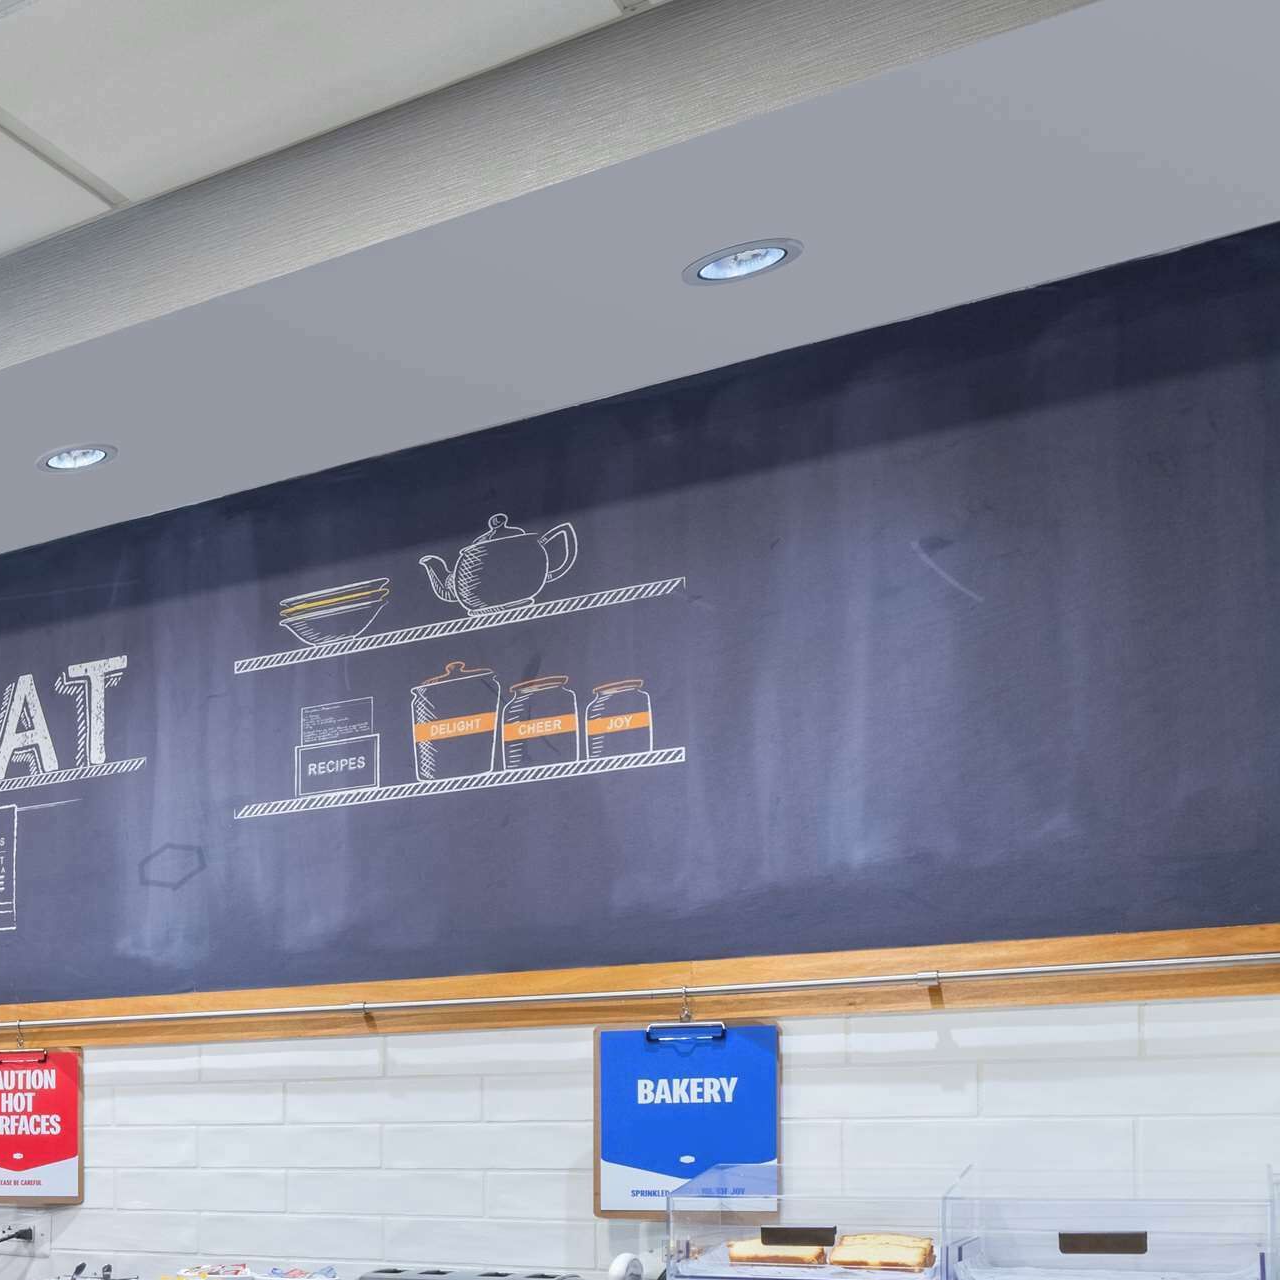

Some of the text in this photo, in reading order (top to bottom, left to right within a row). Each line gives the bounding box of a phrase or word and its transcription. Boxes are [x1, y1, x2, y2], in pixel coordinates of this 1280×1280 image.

[430, 718, 482, 736] DELIGHT
[518, 719, 562, 736] CHEER
[607, 715, 633, 730] JOY
[308, 756, 366, 776] RECIPES
[637, 1077, 738, 1104] BAKERY
[1, 1092, 36, 1113] HOT
